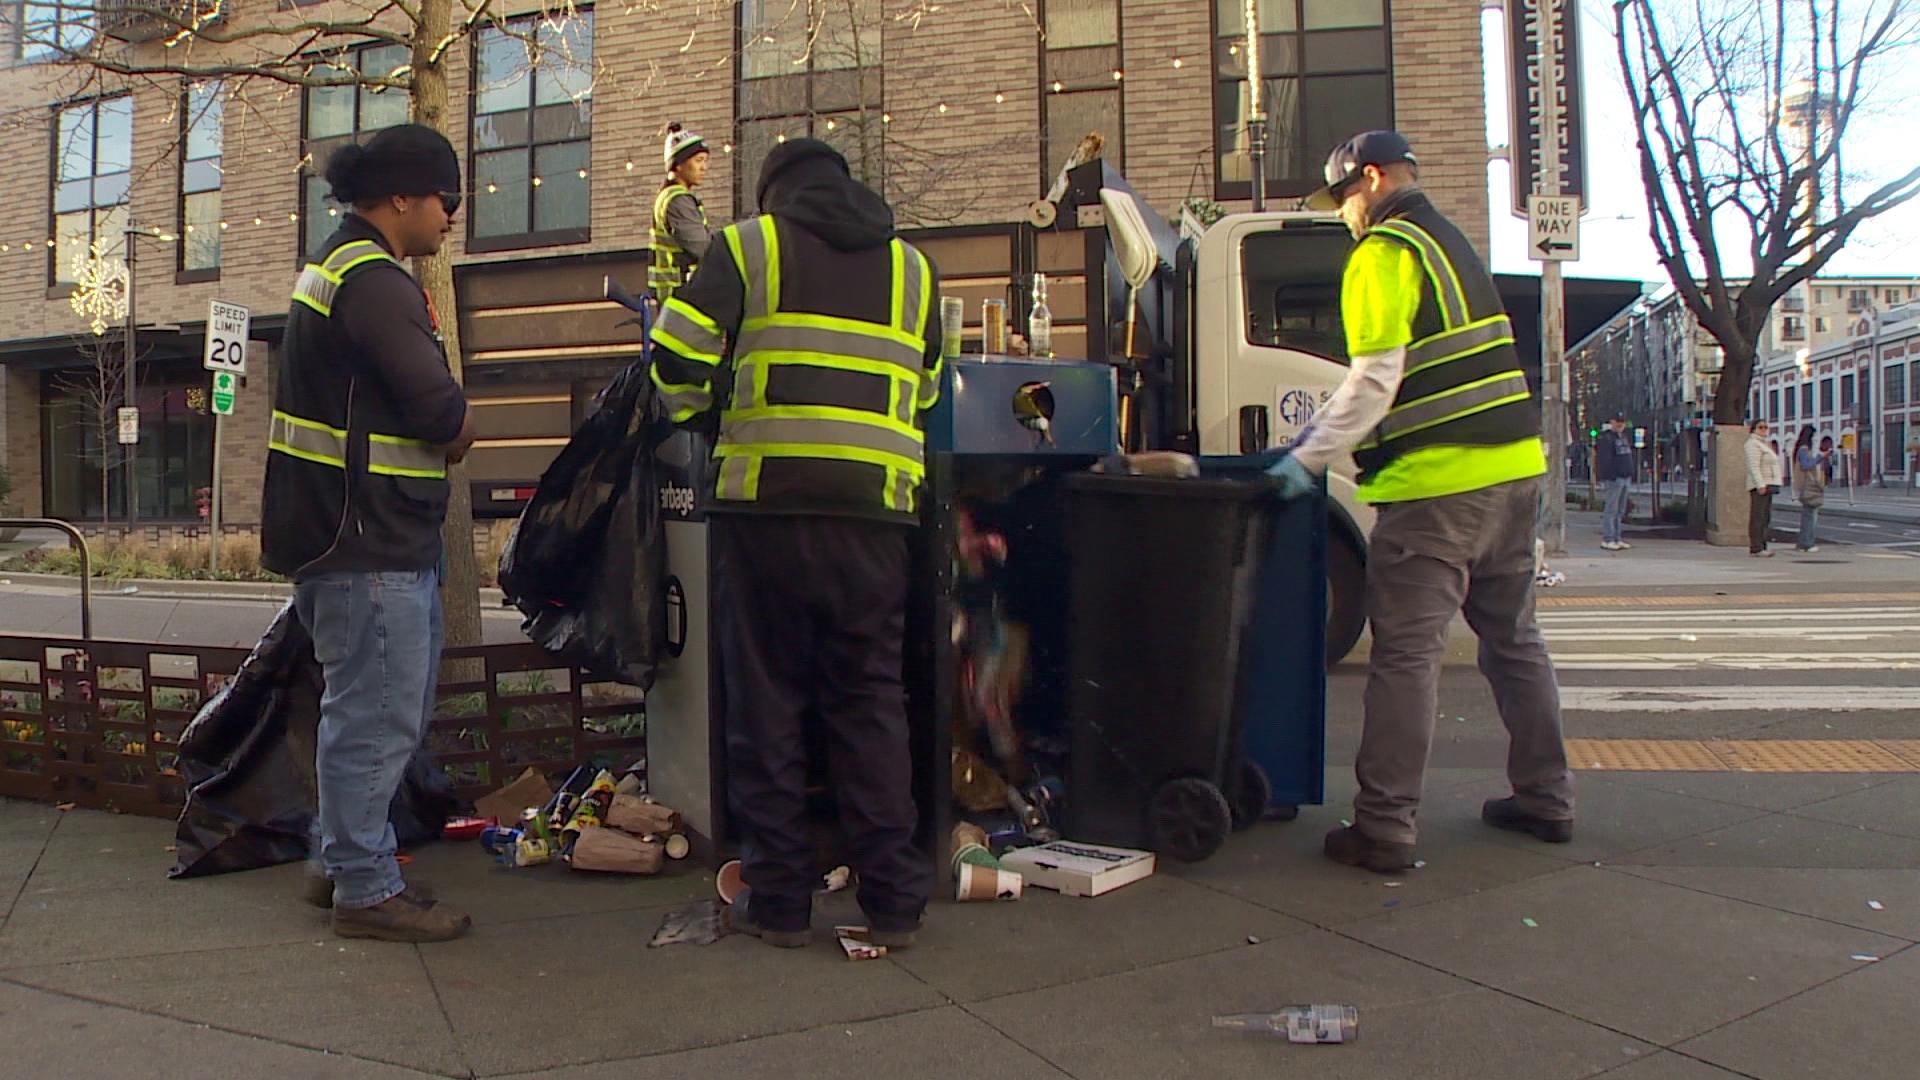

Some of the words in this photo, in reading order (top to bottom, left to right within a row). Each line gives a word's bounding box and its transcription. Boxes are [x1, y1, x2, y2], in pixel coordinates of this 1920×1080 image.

[1524, 0, 1570, 196] NFIDENTIAL
[1537, 201, 1570, 216] ONE
[1536, 219, 1572, 233] WAY
[213, 305, 246, 321] SPEED
[214, 320, 242, 335] LIMIT
[211, 338, 243, 365] 20
[660, 480, 694, 516] arbage
